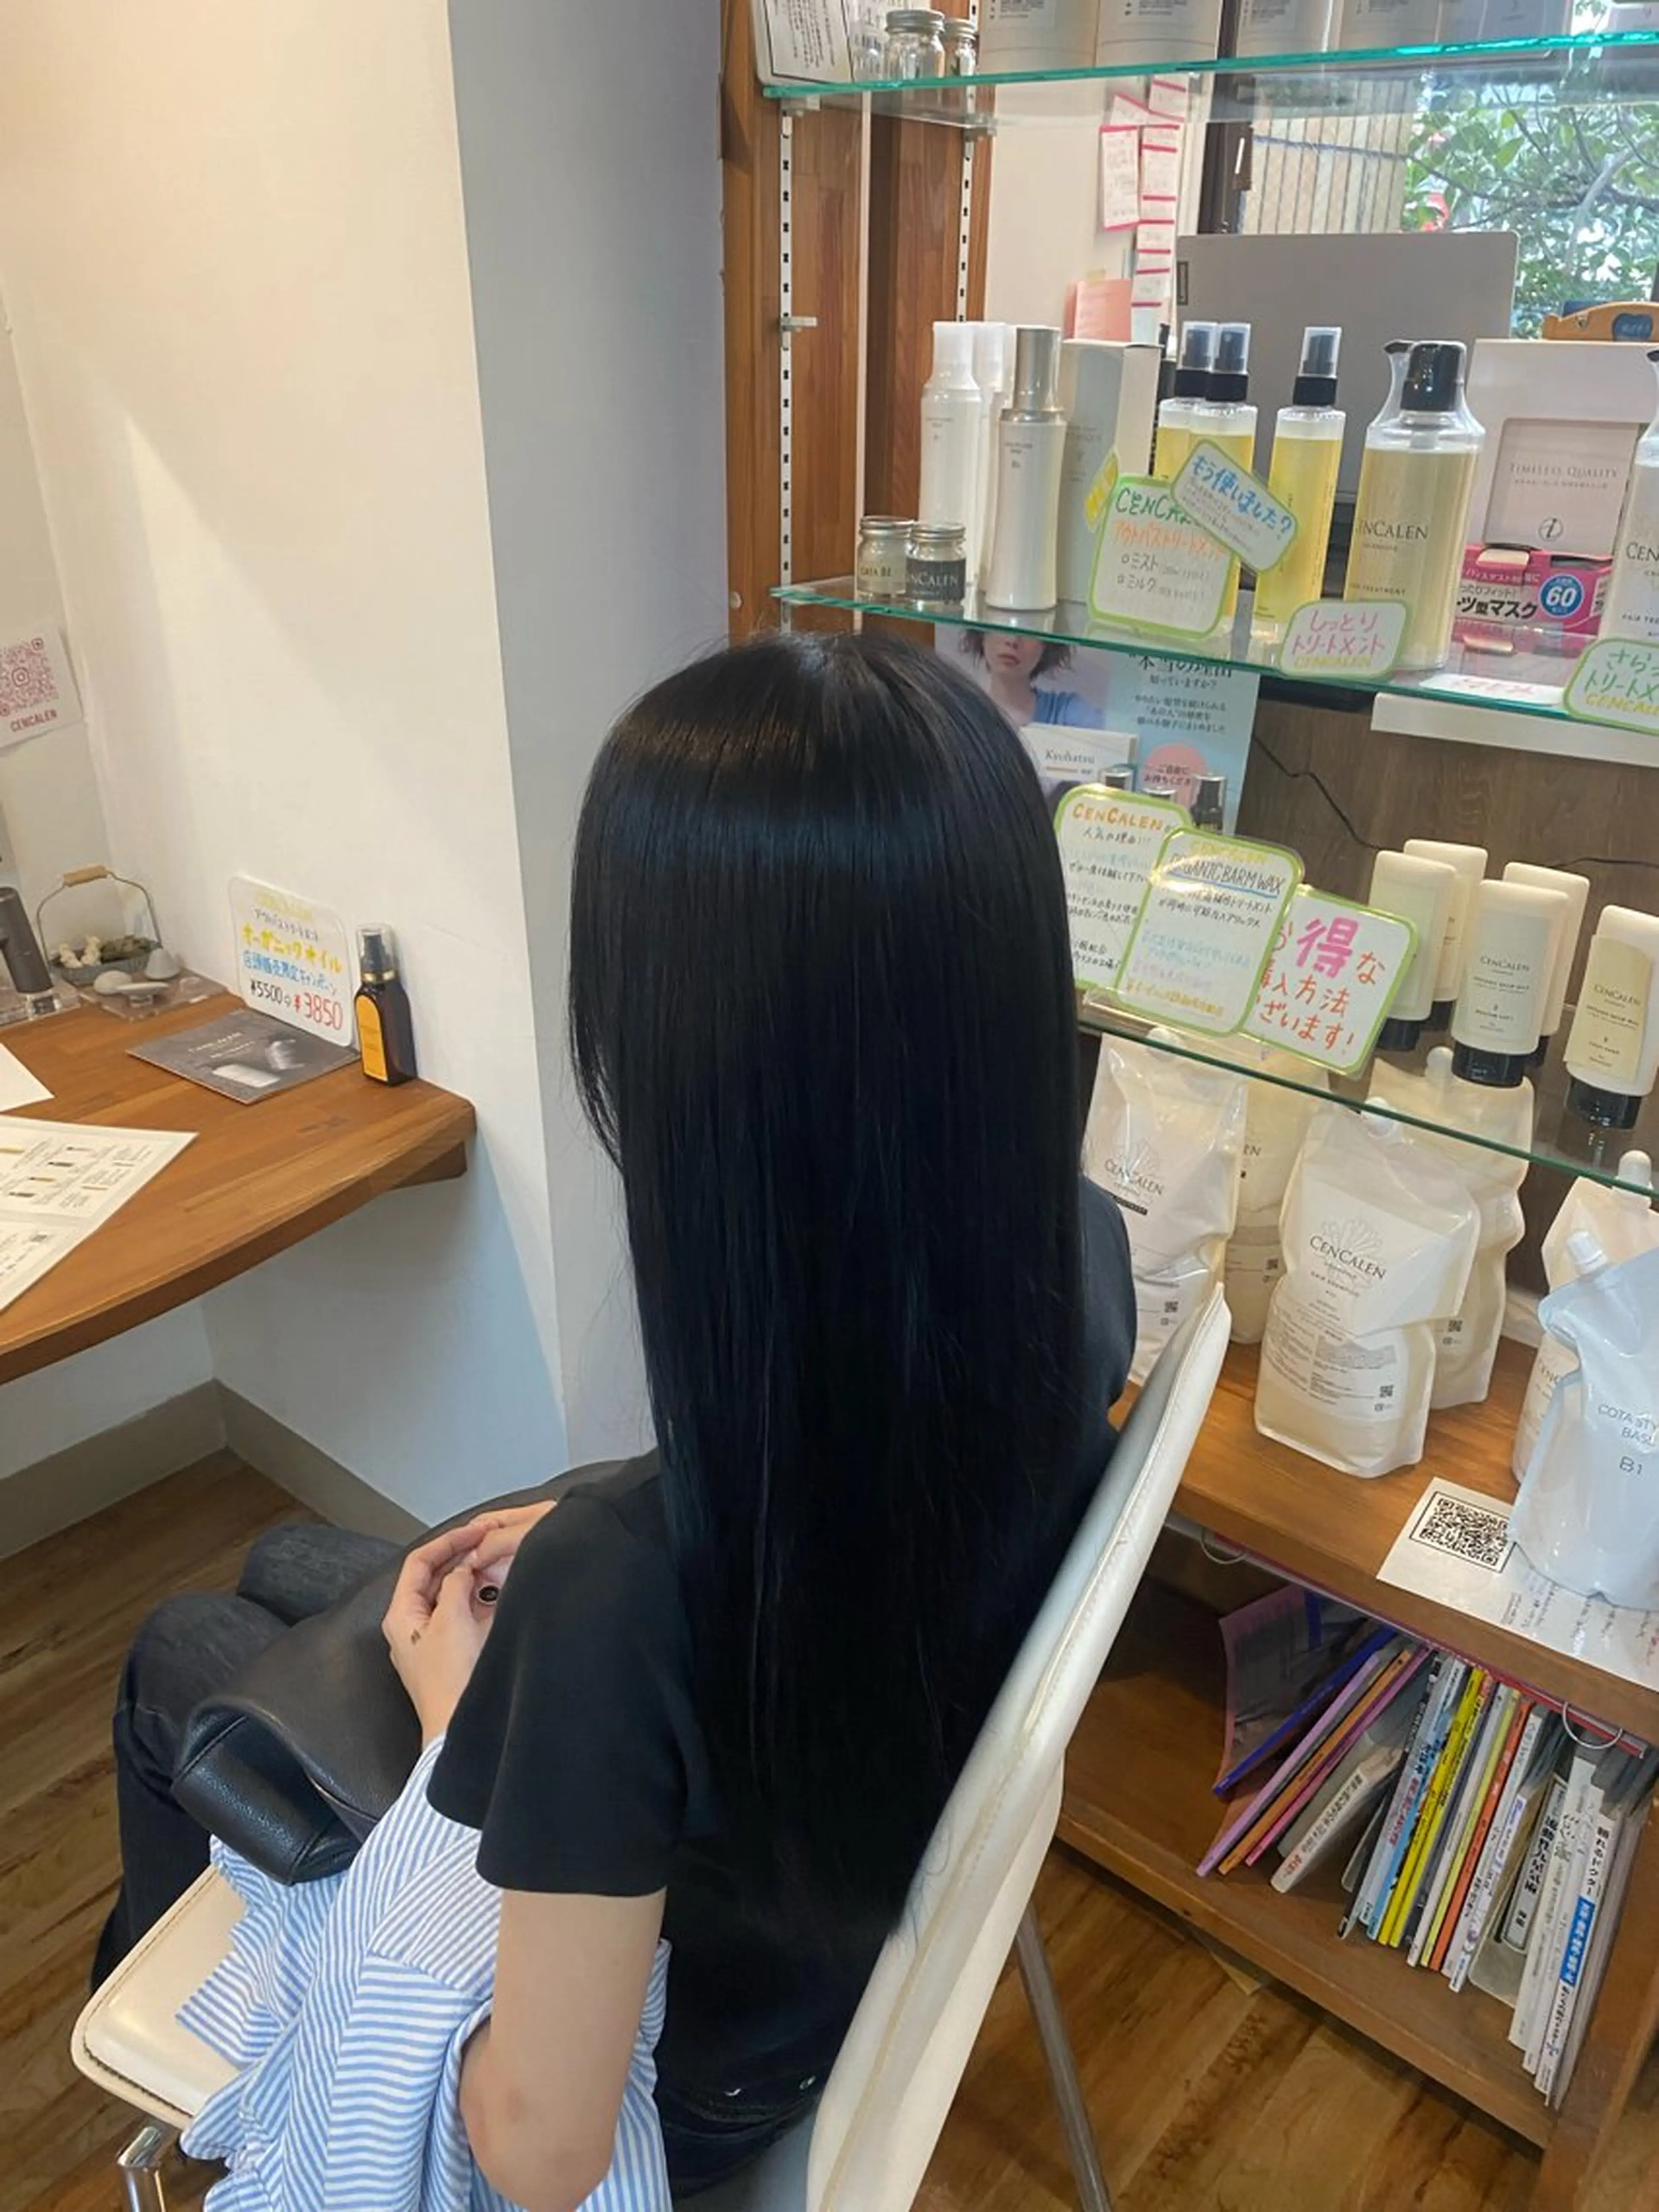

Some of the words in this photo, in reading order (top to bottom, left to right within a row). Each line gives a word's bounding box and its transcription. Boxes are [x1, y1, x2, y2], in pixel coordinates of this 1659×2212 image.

[1456, 596, 1539, 620] ツ型マスク
[1545, 586, 1577, 607] 60
[1310, 609, 1379, 632] しっとり
[1292, 632, 1386, 655] トリートメント
[10, 709, 58, 733] CENCALEN
[1073, 804, 1163, 830] CENCALEN
[294, 992, 344, 1031] ¥3850
[1255, 995, 1354, 1055] ざいます!
[1104, 1158, 1165, 1196] CENALEN
[1310, 1236, 1387, 1281] CENCALEN
[1619, 1456, 1643, 1475] B1
